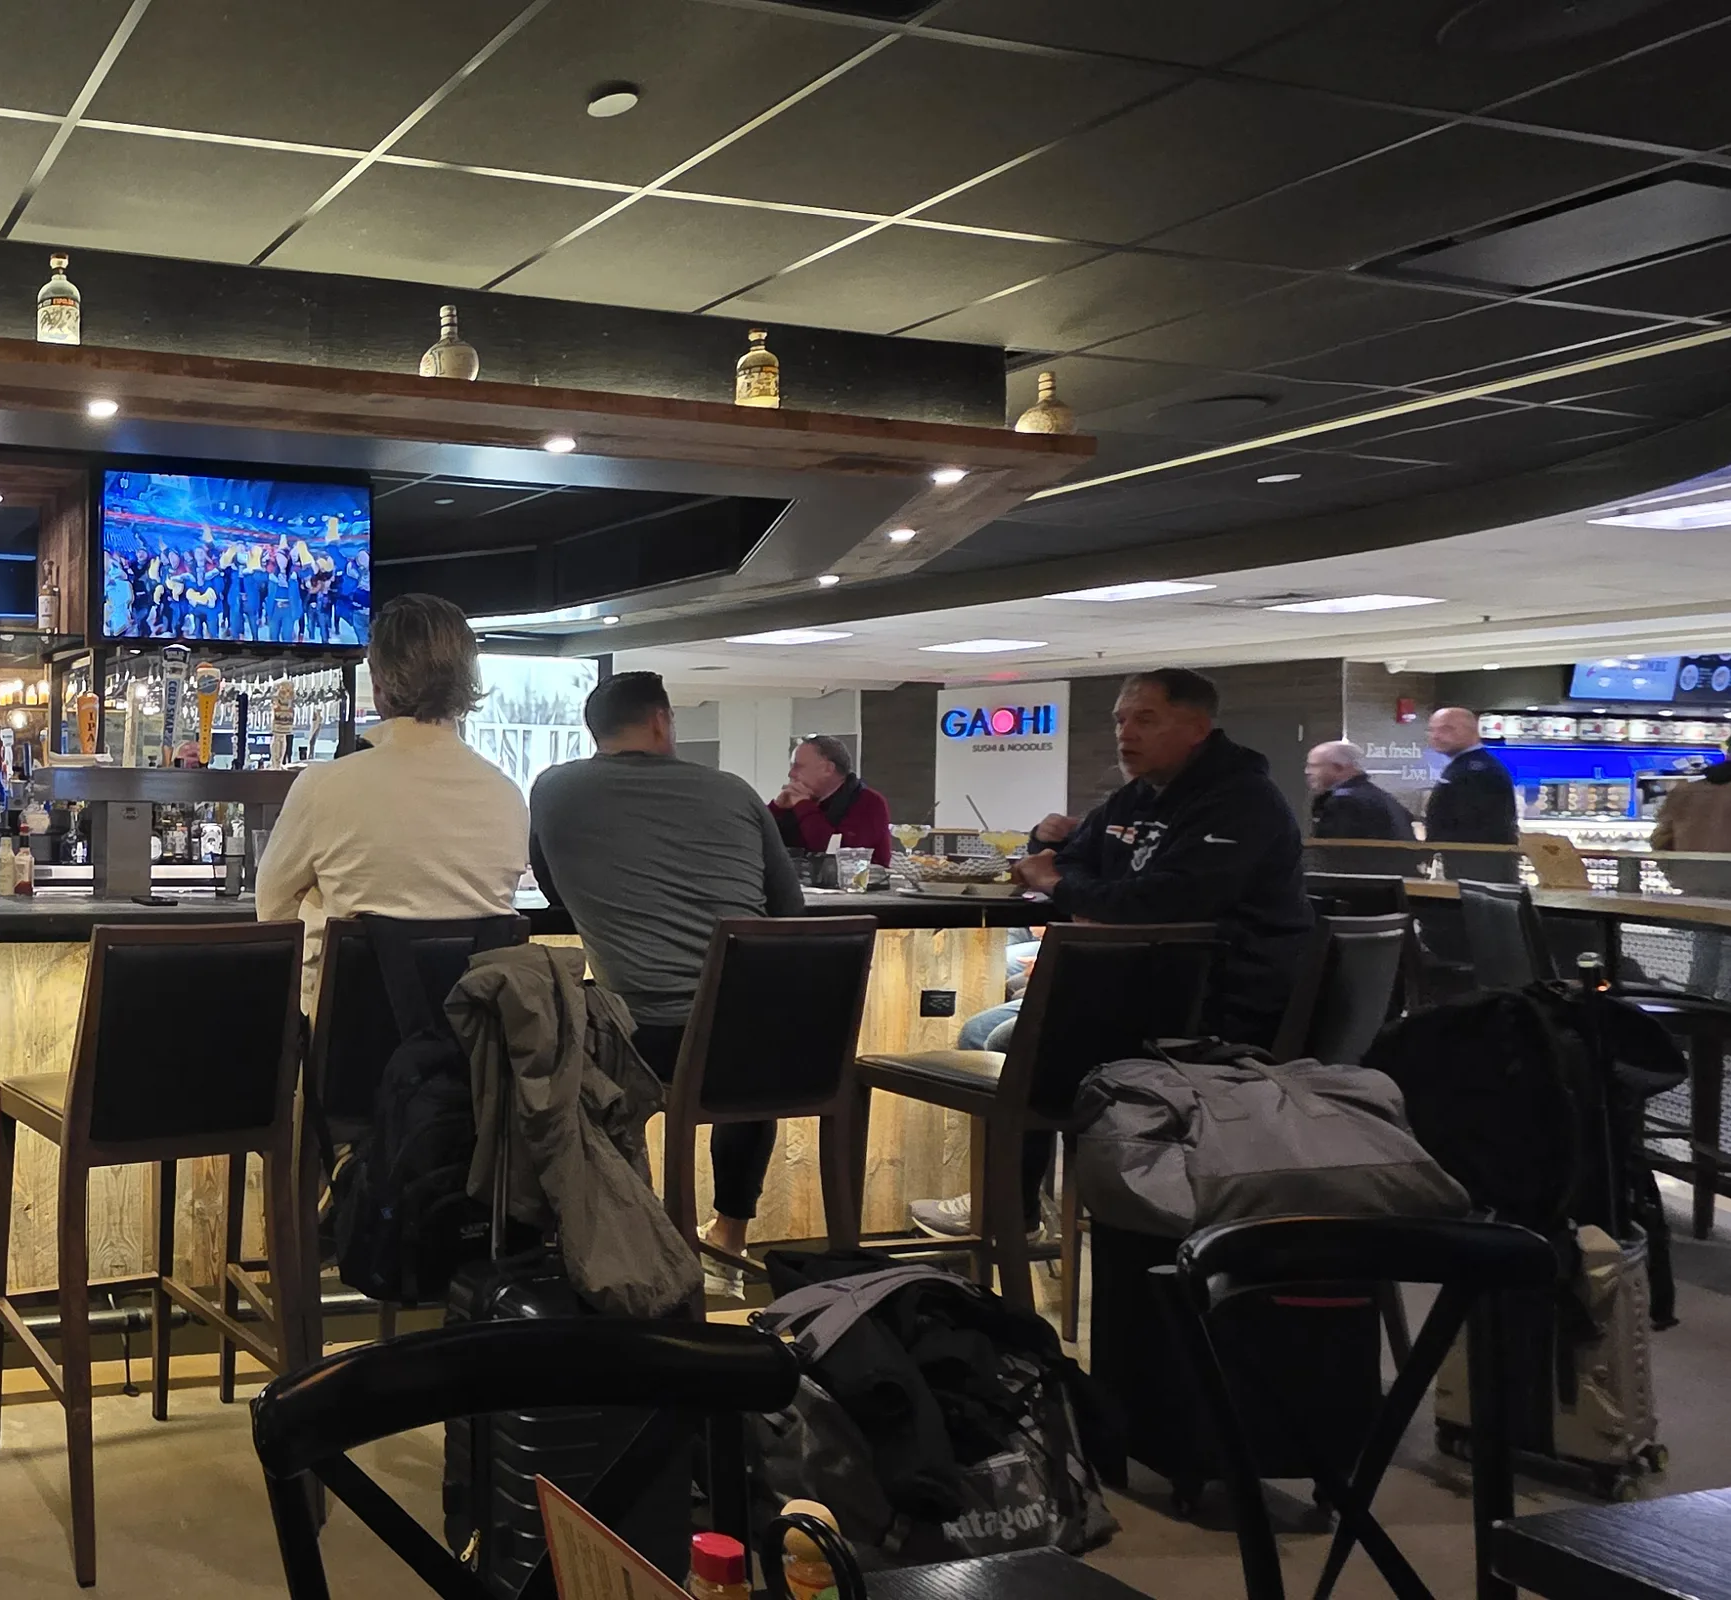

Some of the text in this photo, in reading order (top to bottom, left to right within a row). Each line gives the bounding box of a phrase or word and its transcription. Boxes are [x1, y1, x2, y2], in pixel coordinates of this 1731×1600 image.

[165, 681, 177, 733] COLD SNAP
[87, 712, 95, 742] IPA
[972, 742, 1053, 752] SUSHI & NOODLES
[1366, 741, 1422, 758] Eat fresh
[942, 1495, 1058, 1540] atagon
